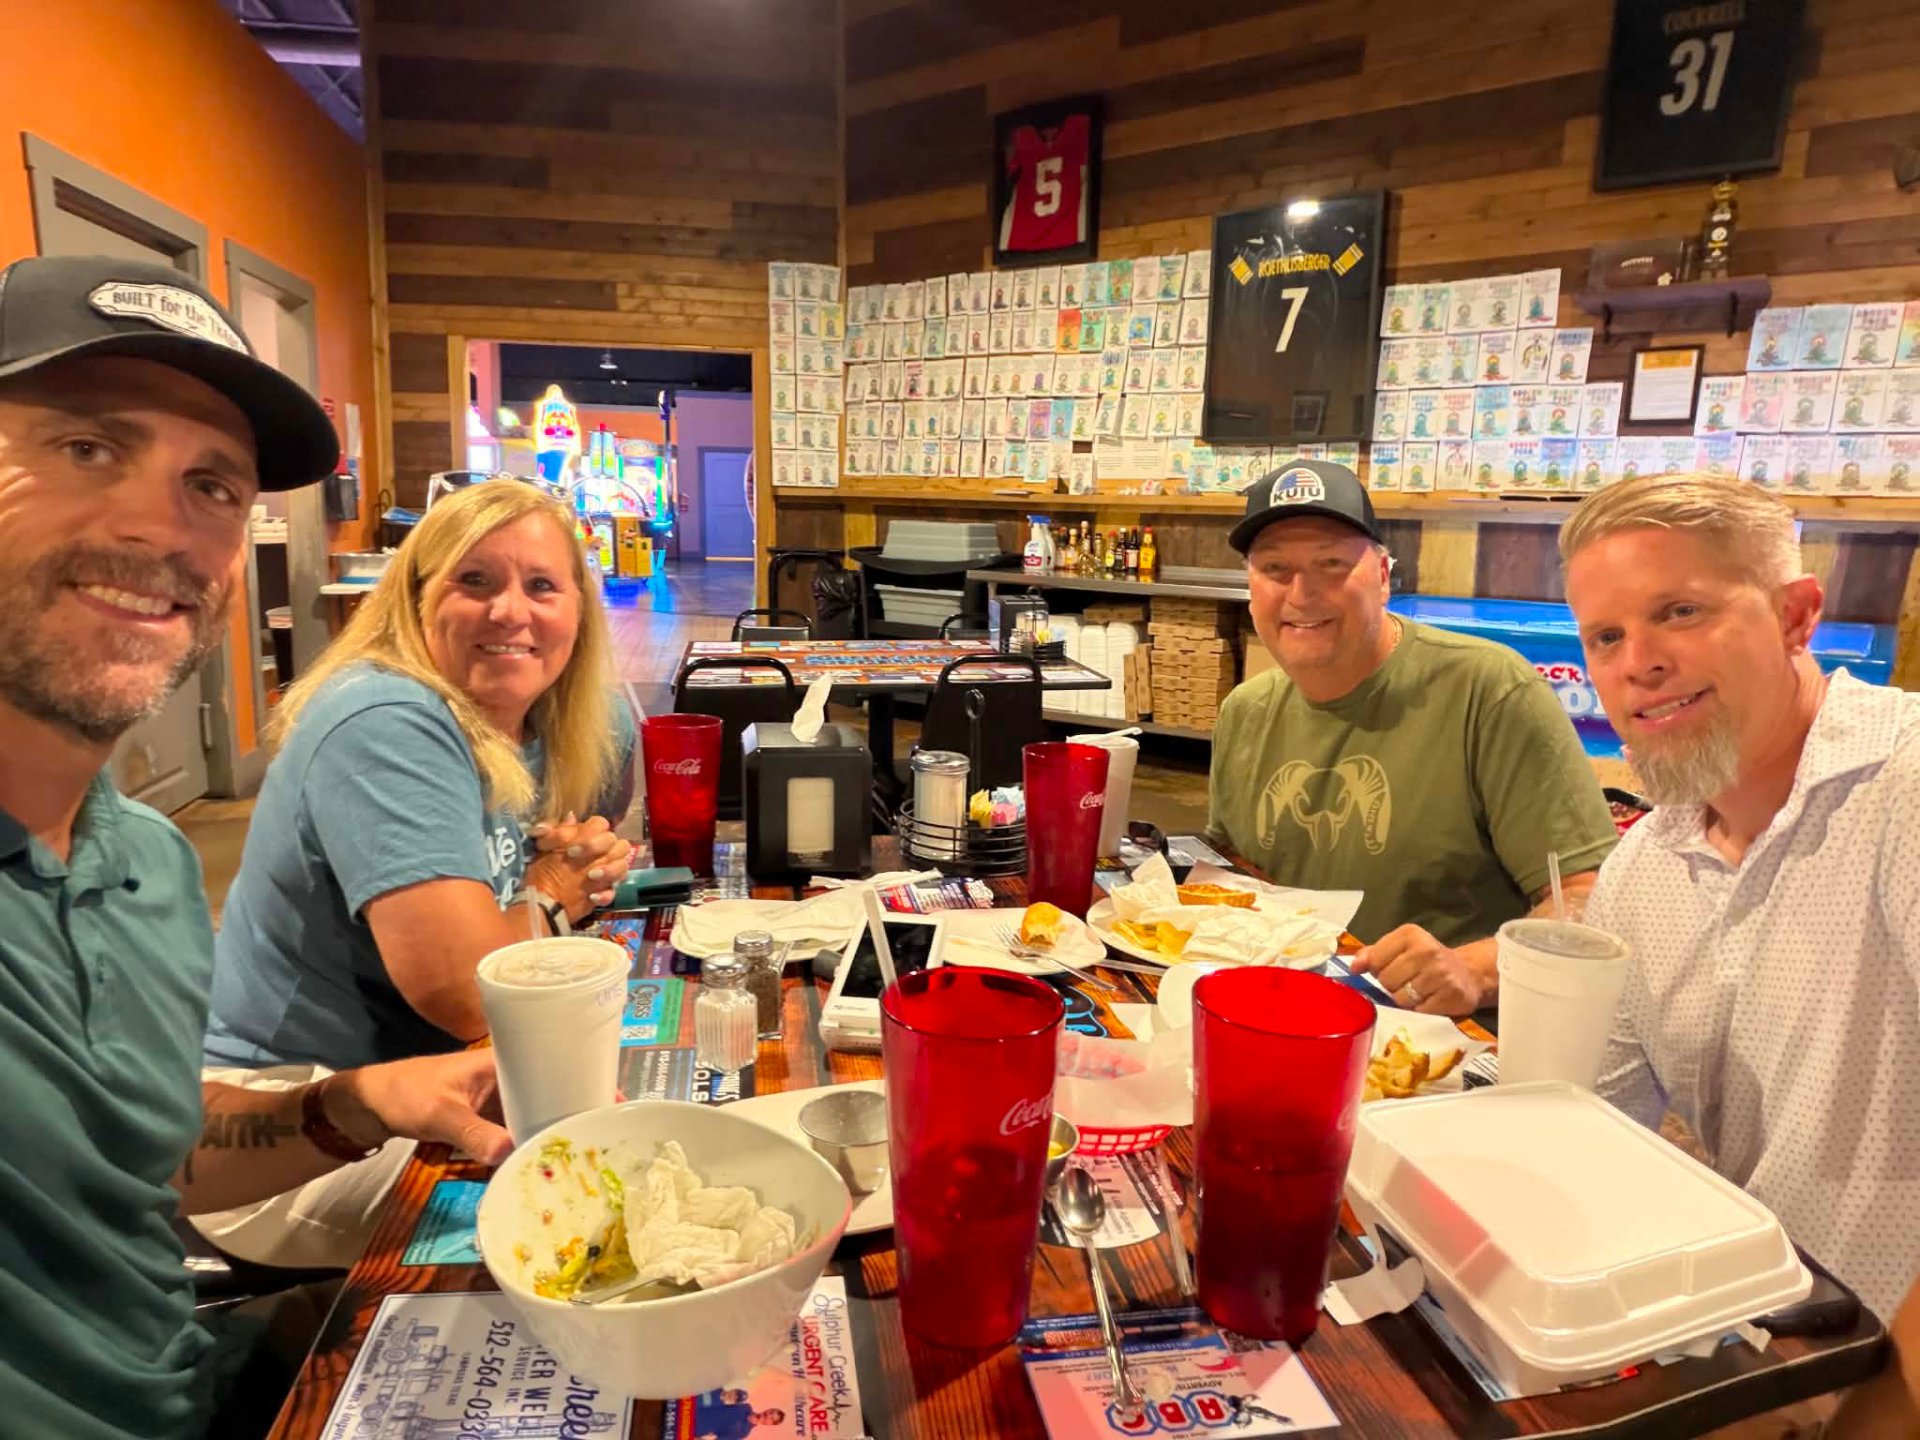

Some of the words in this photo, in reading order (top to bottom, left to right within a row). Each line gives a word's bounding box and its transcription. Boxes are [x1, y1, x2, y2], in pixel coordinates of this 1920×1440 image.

[1660, 31, 1735, 116] 31
[1034, 157, 1063, 217] 5
[113, 292, 156, 308] BUILT
[161, 296, 182, 316] for
[185, 305, 207, 326] the
[1275, 287, 1309, 353] 7
[1274, 487, 1321, 503] KUIU
[802, 1315, 825, 1377] URGENT
[813, 1294, 845, 1351] Sulphur
[511, 1347, 533, 1381] SERVICE
[828, 1355, 850, 1396] Creek
[515, 1387, 551, 1434] WELL
